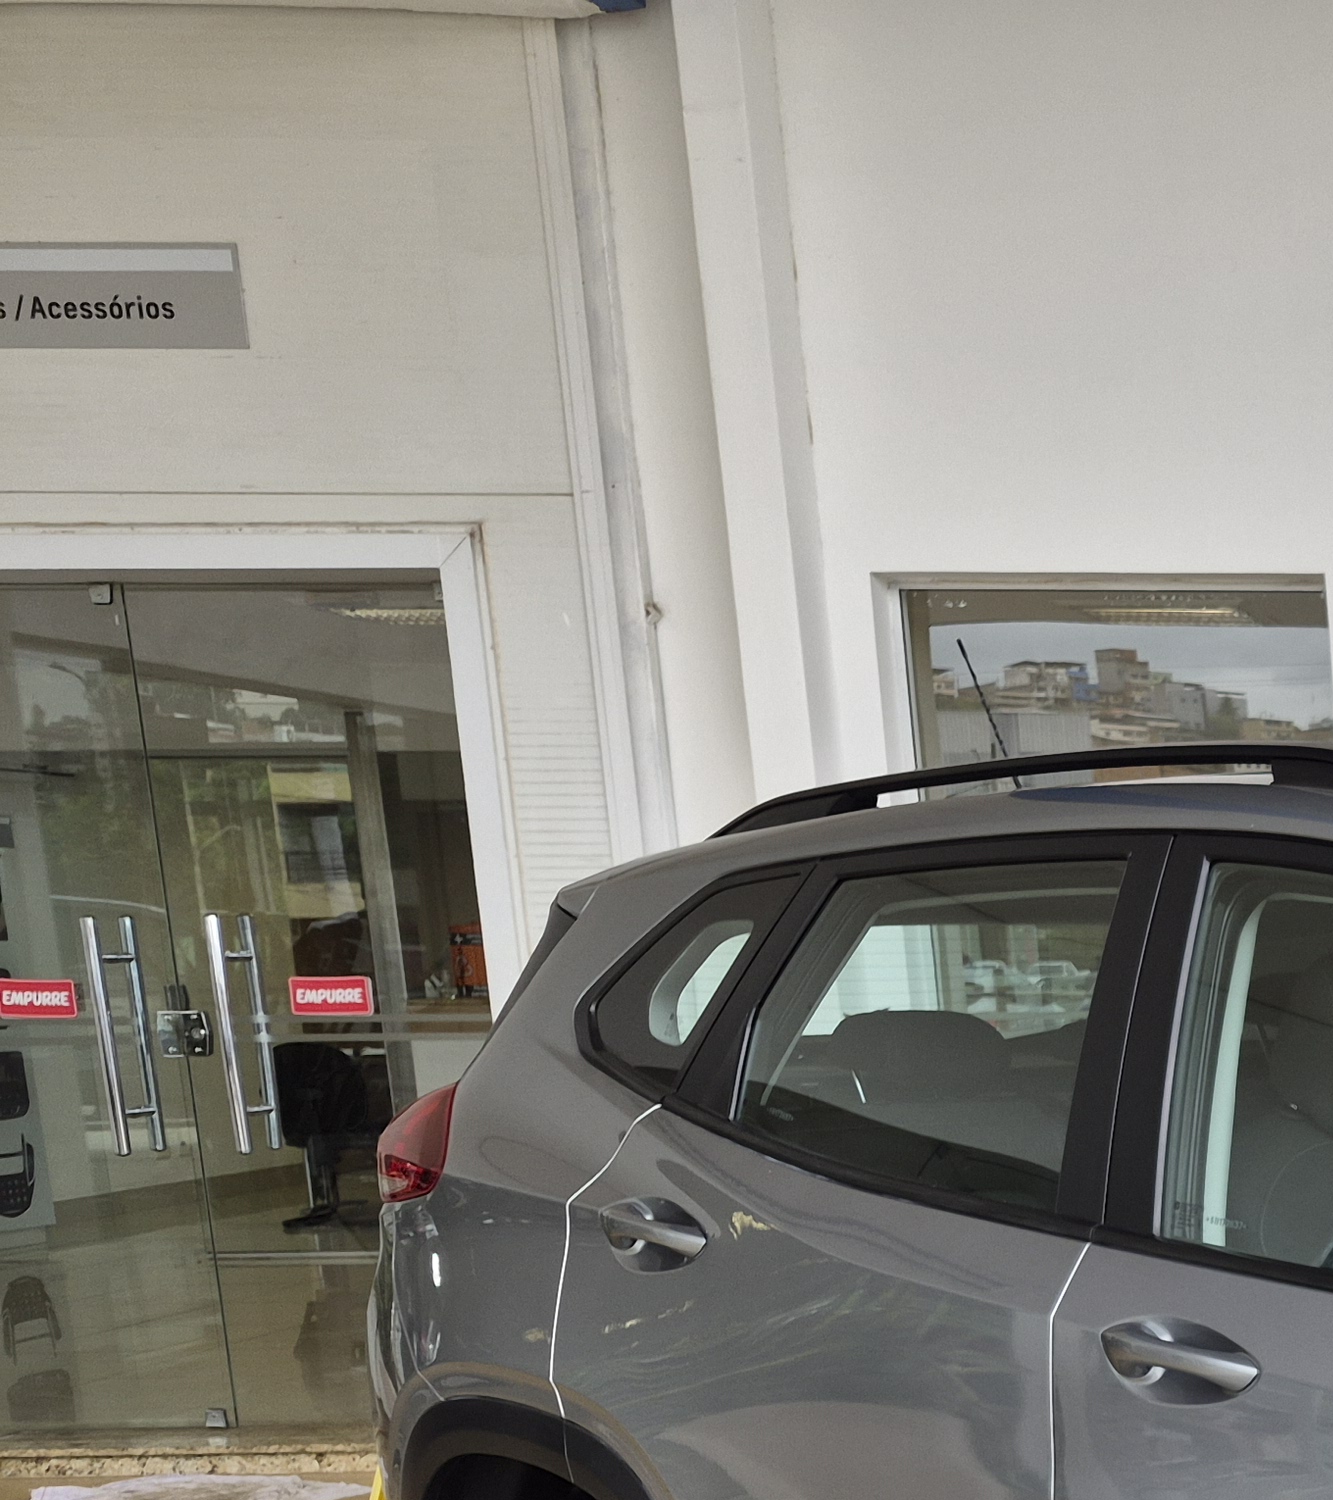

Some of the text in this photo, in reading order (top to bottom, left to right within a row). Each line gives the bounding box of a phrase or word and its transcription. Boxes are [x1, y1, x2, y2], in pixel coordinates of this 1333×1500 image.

[30, 294, 176, 320] Acessórios
[2, 990, 70, 1007] EMPURRE
[295, 988, 364, 1004] EMPURRE
